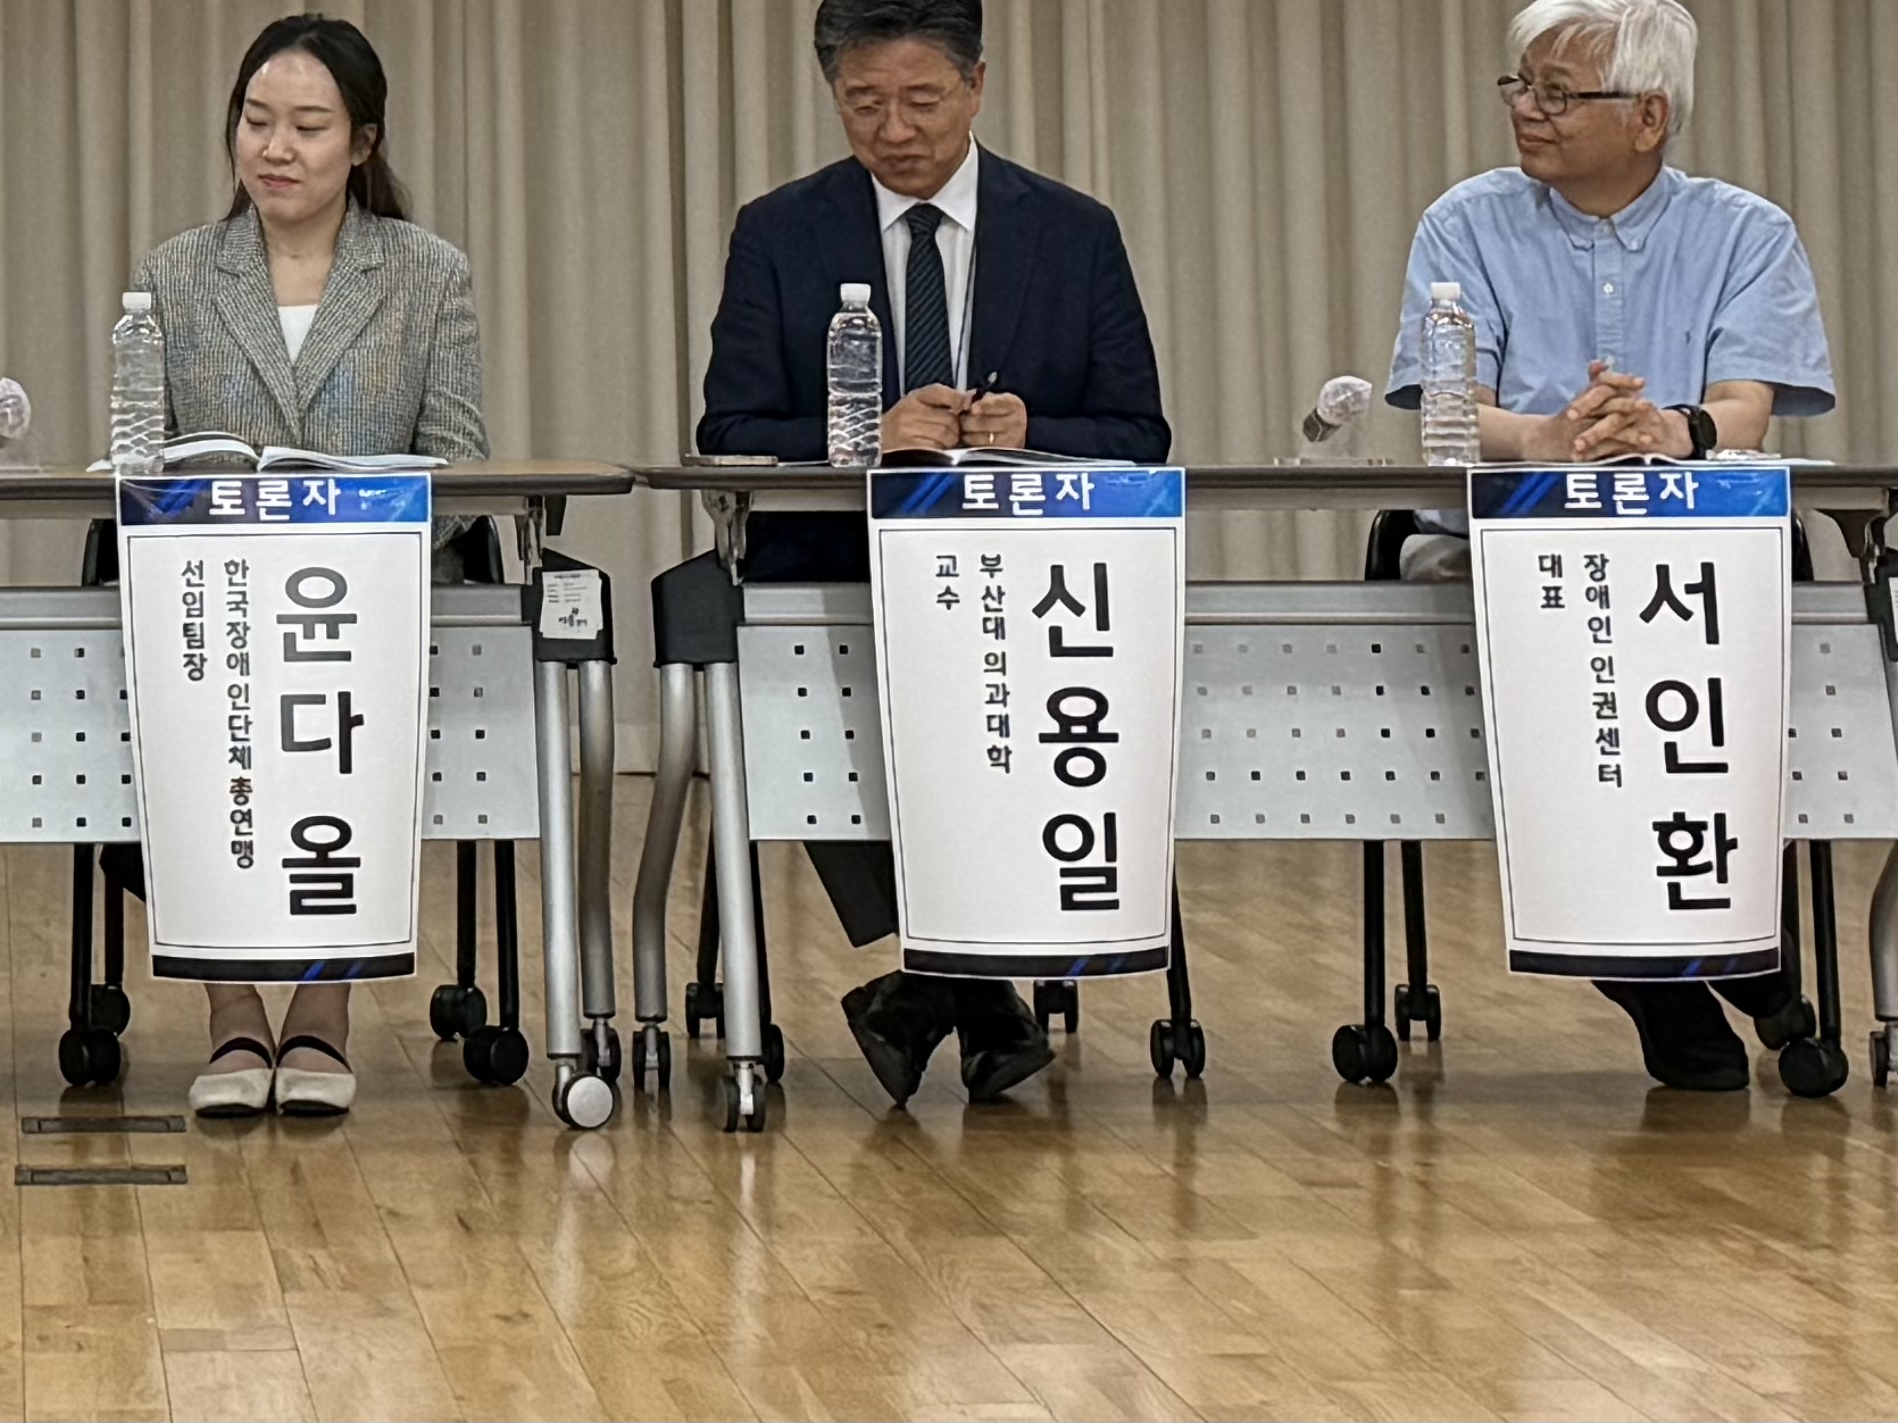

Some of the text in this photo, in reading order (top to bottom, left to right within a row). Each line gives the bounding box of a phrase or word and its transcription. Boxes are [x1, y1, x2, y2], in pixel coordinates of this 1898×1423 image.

[208, 478, 341, 521] 토론자
[961, 472, 1095, 516] 토론자
[1564, 471, 1699, 516] 토론자
[181, 559, 208, 682] 선임팀장
[935, 554, 961, 611] 교수
[1538, 553, 1566, 609] 대표
[223, 558, 255, 870] 한국장애인단체총연맹
[276, 566, 365, 916] 윤다올
[1031, 562, 1120, 912] 신용일
[1639, 561, 1739, 911] 서인환
